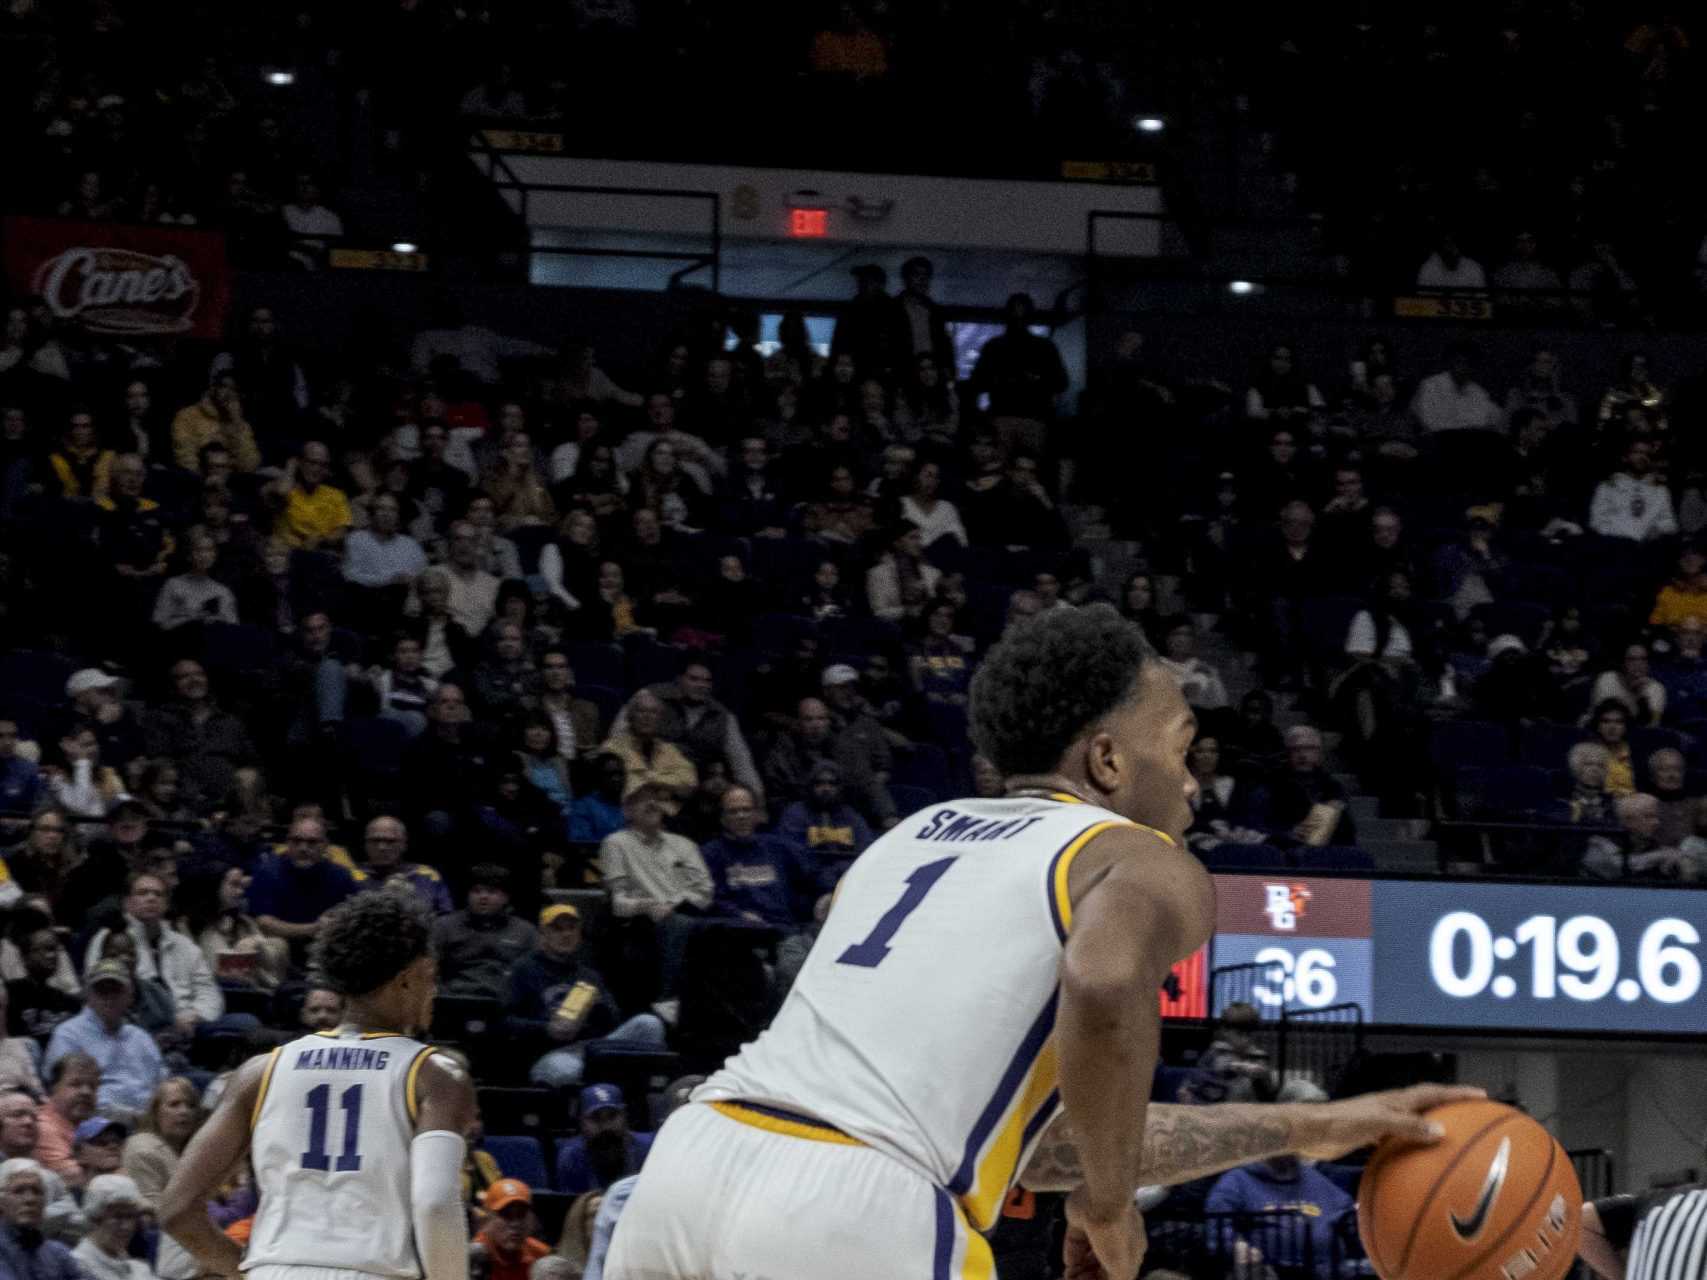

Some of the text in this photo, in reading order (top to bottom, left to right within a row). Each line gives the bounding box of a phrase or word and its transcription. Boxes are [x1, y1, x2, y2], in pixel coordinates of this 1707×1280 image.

[915, 809, 1046, 842] SMART
[835, 855, 960, 969] 1
[1253, 947, 1337, 1007] 36
[1429, 911, 1702, 1004] 0:19.6
[294, 1046, 391, 1071] MANNING
[302, 1084, 363, 1172] 11
